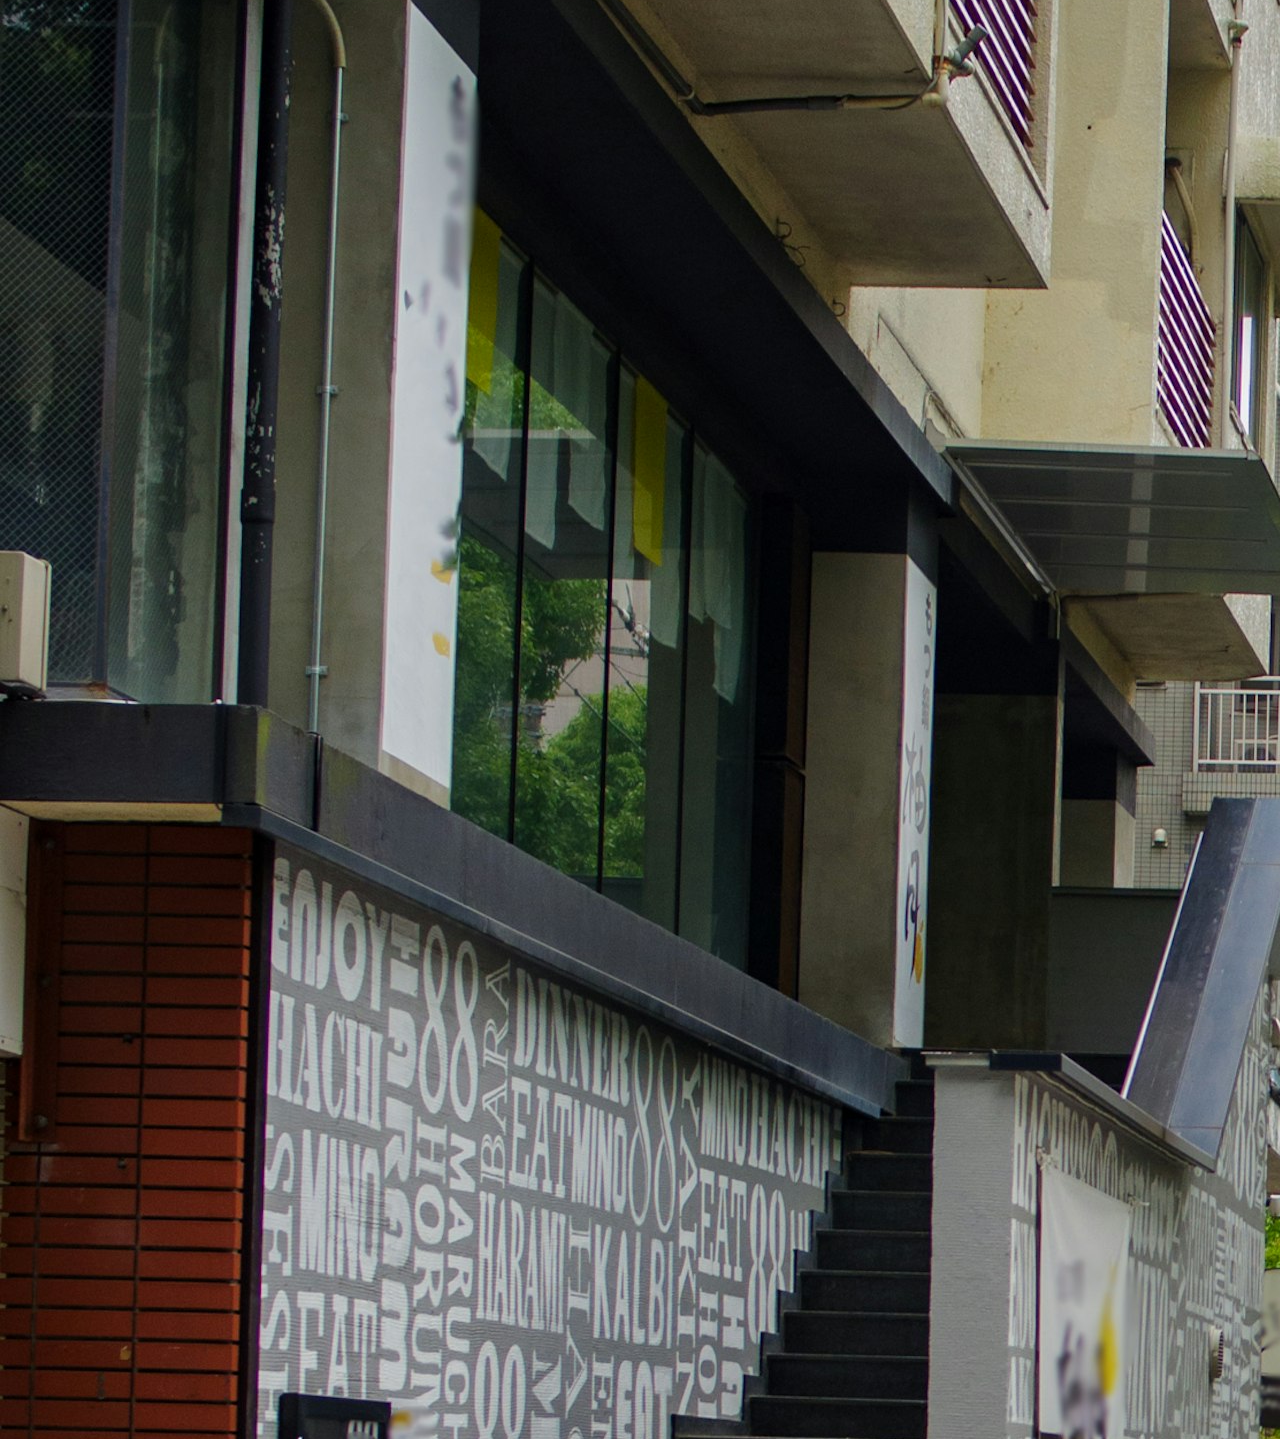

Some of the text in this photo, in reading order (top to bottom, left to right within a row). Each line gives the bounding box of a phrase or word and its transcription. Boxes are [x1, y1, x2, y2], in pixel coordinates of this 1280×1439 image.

[266, 989, 384, 1132] HACHI
[513, 966, 631, 1109] DINNER
[507, 1075, 573, 1199] EAT
[474, 1189, 568, 1335] HARAMI
[593, 1223, 676, 1350] KALBI
[697, 1167, 748, 1284] EAT
